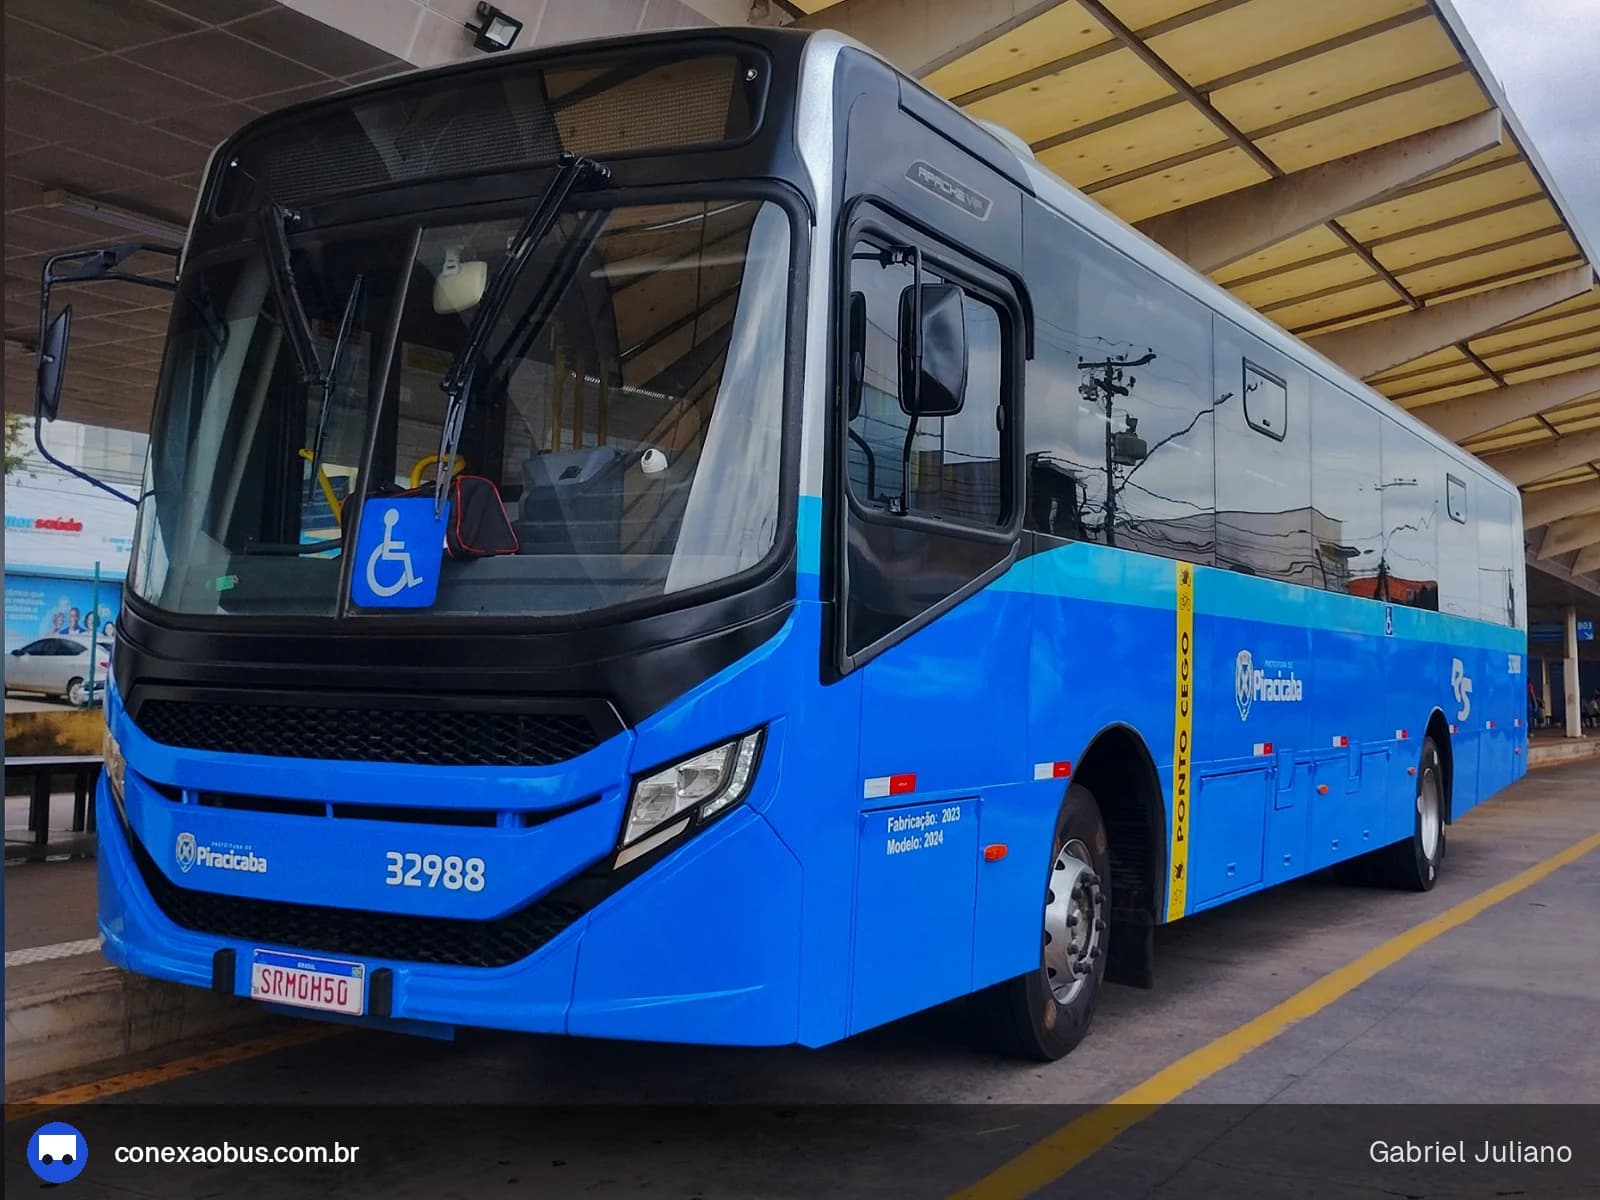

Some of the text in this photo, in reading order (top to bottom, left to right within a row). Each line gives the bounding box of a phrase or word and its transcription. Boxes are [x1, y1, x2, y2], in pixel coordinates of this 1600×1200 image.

[1253, 669, 1303, 702] Piracicaba
[1177, 631, 1189, 842] PONTO CEGO
[887, 806, 961, 833] Fabricação: 2023
[887, 830, 944, 855] Modelo: 2024
[196, 846, 267, 873] Piracicaba
[385, 851, 485, 892] 32988
